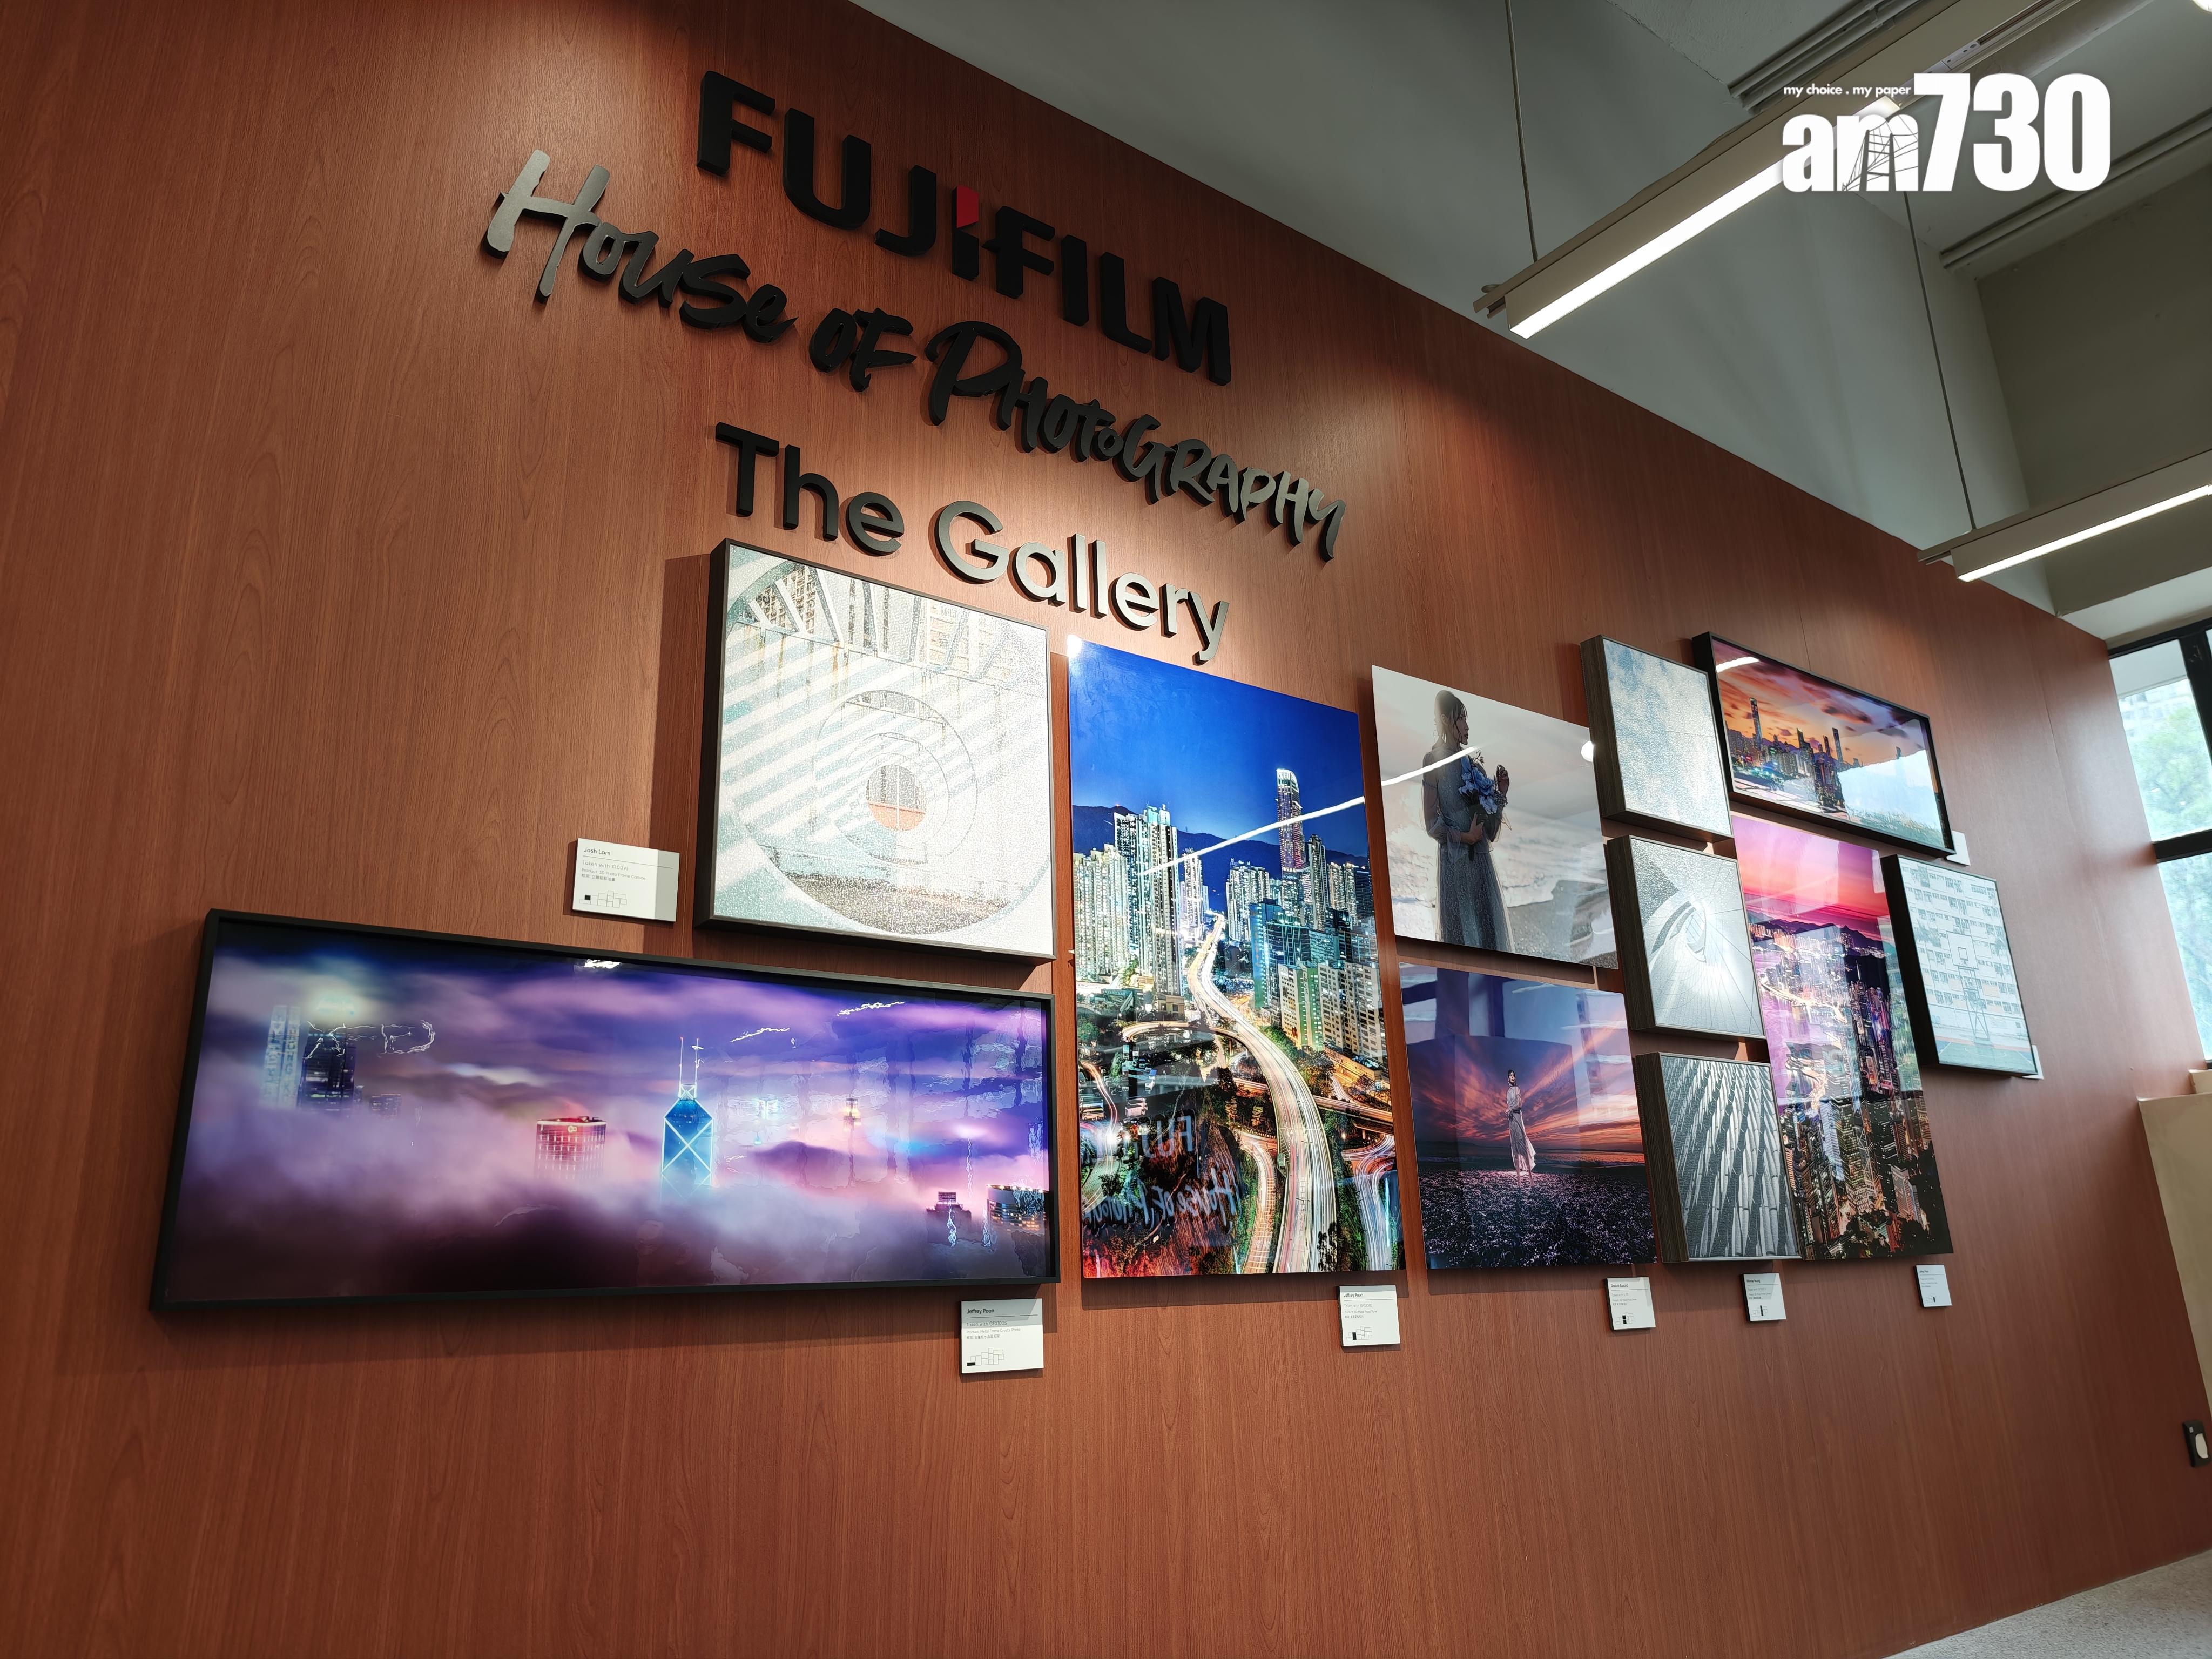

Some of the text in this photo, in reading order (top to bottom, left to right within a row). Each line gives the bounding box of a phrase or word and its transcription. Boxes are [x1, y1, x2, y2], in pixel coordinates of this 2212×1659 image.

[697, 71, 1232, 386] FUJIFILM
[716, 422, 1229, 664] The Gallery
